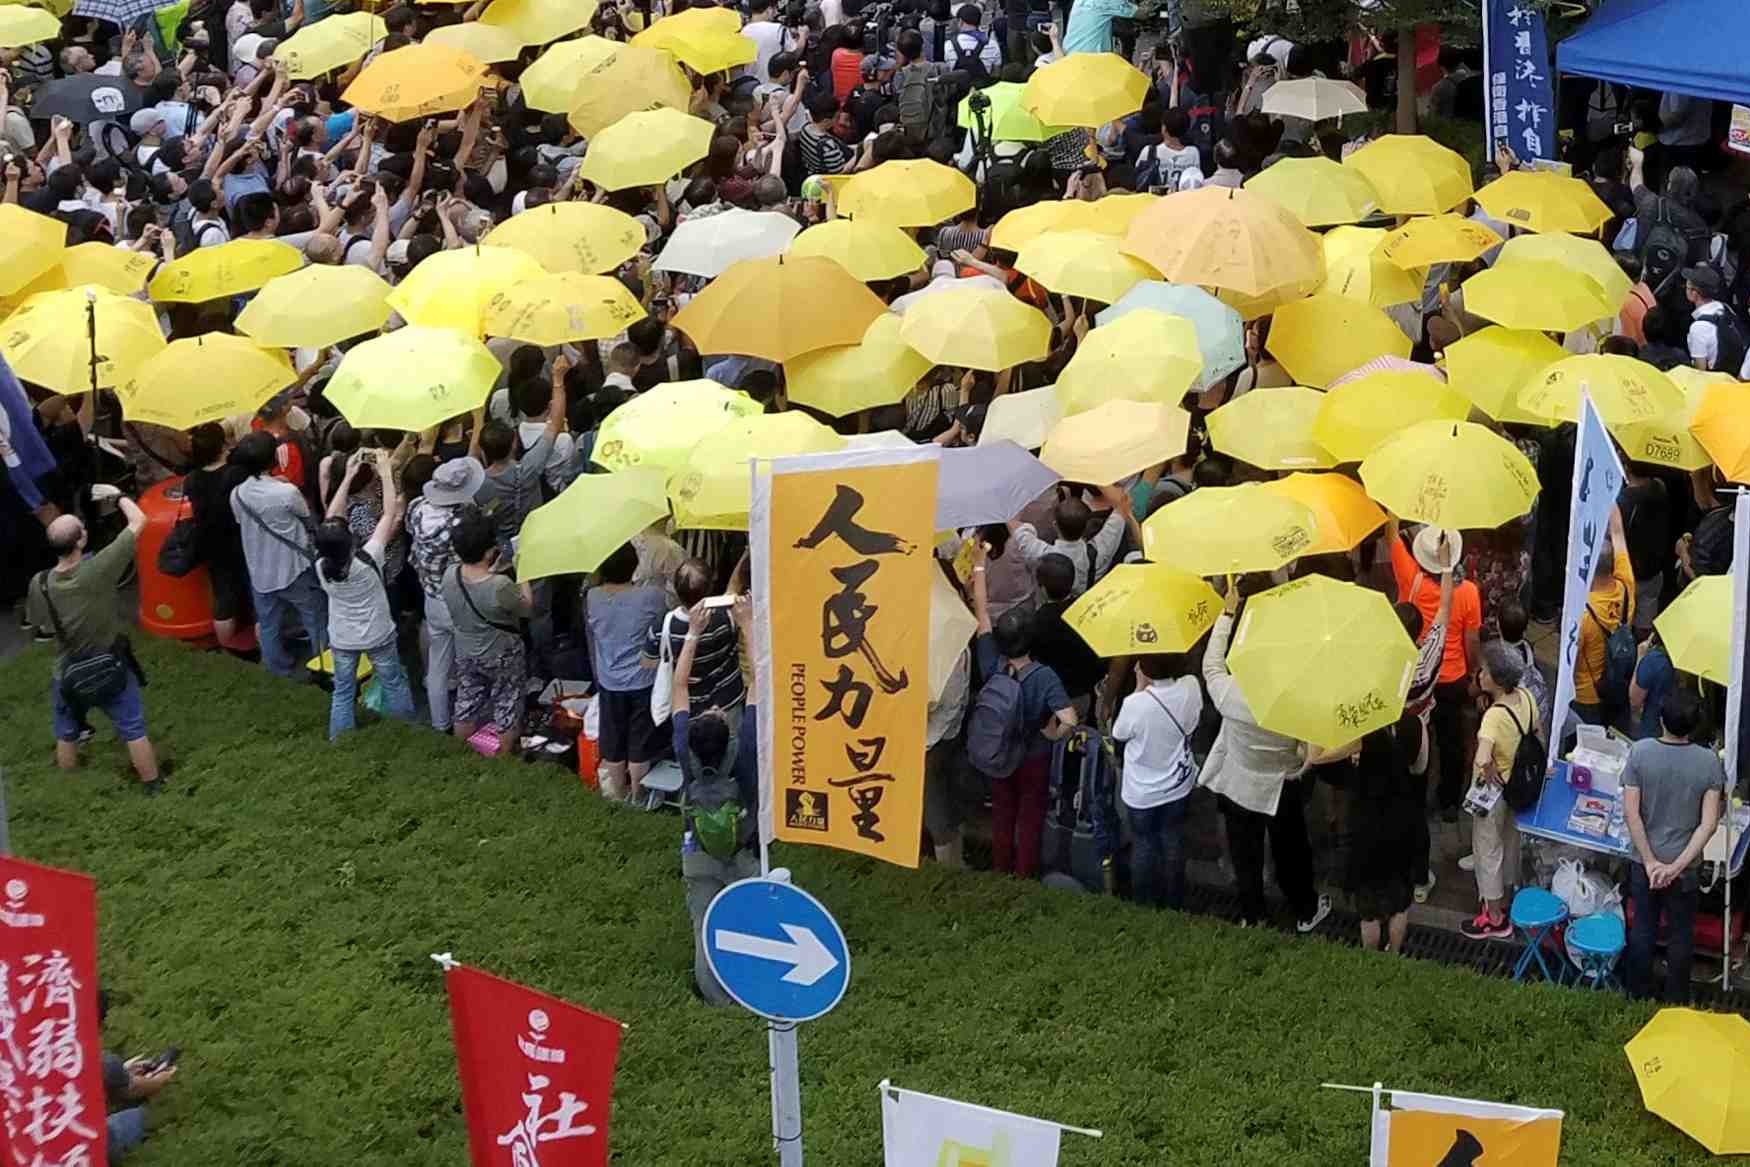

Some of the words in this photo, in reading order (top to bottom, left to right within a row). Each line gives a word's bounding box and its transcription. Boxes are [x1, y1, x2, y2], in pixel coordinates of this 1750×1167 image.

[791, 483, 918, 844] 人民力量
[791, 663, 806, 723] PEOPLE
[791, 726, 806, 785] POWER
[17, 949, 98, 1167] 濟弱扶
